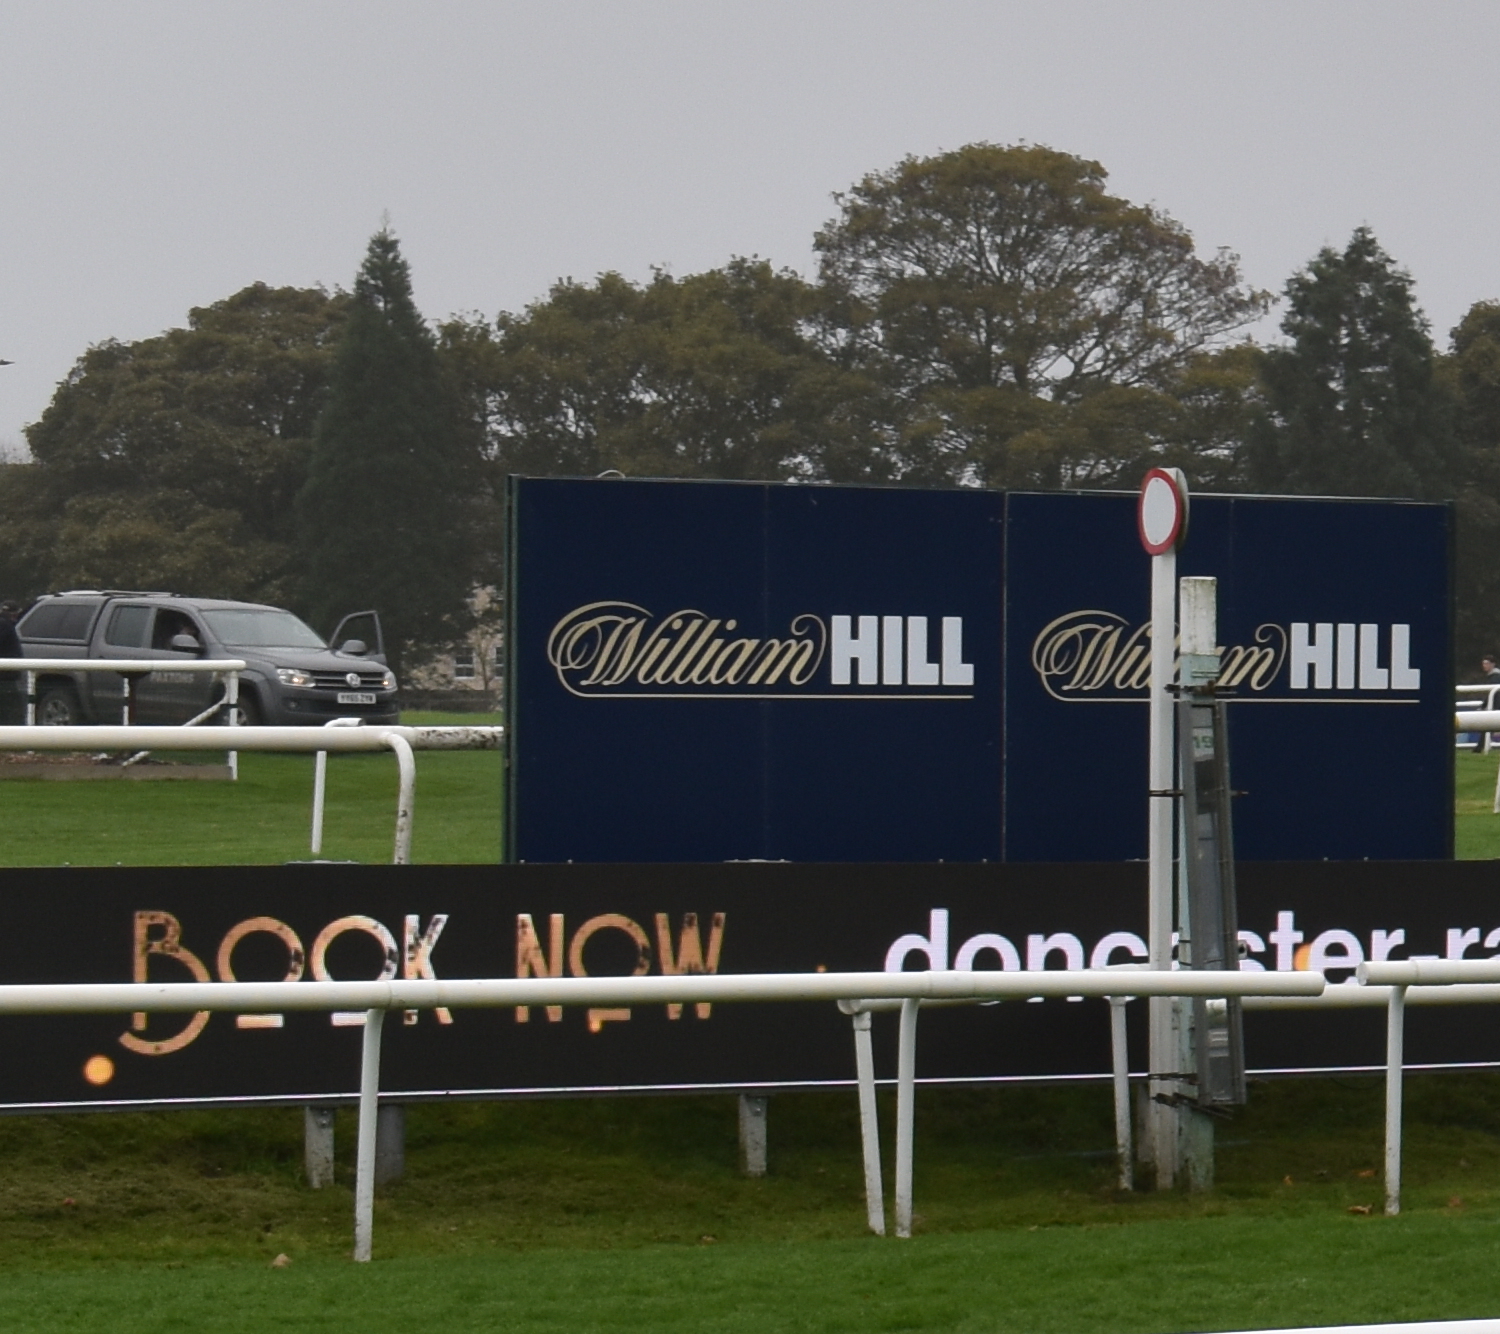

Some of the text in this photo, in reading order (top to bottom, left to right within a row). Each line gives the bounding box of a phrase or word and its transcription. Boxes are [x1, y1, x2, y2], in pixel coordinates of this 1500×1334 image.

[548, 601, 974, 686] William HILL
[1290, 623, 1421, 690] HILL
[119, 910, 453, 1055] BOOK
[515, 911, 726, 1024] NOW
